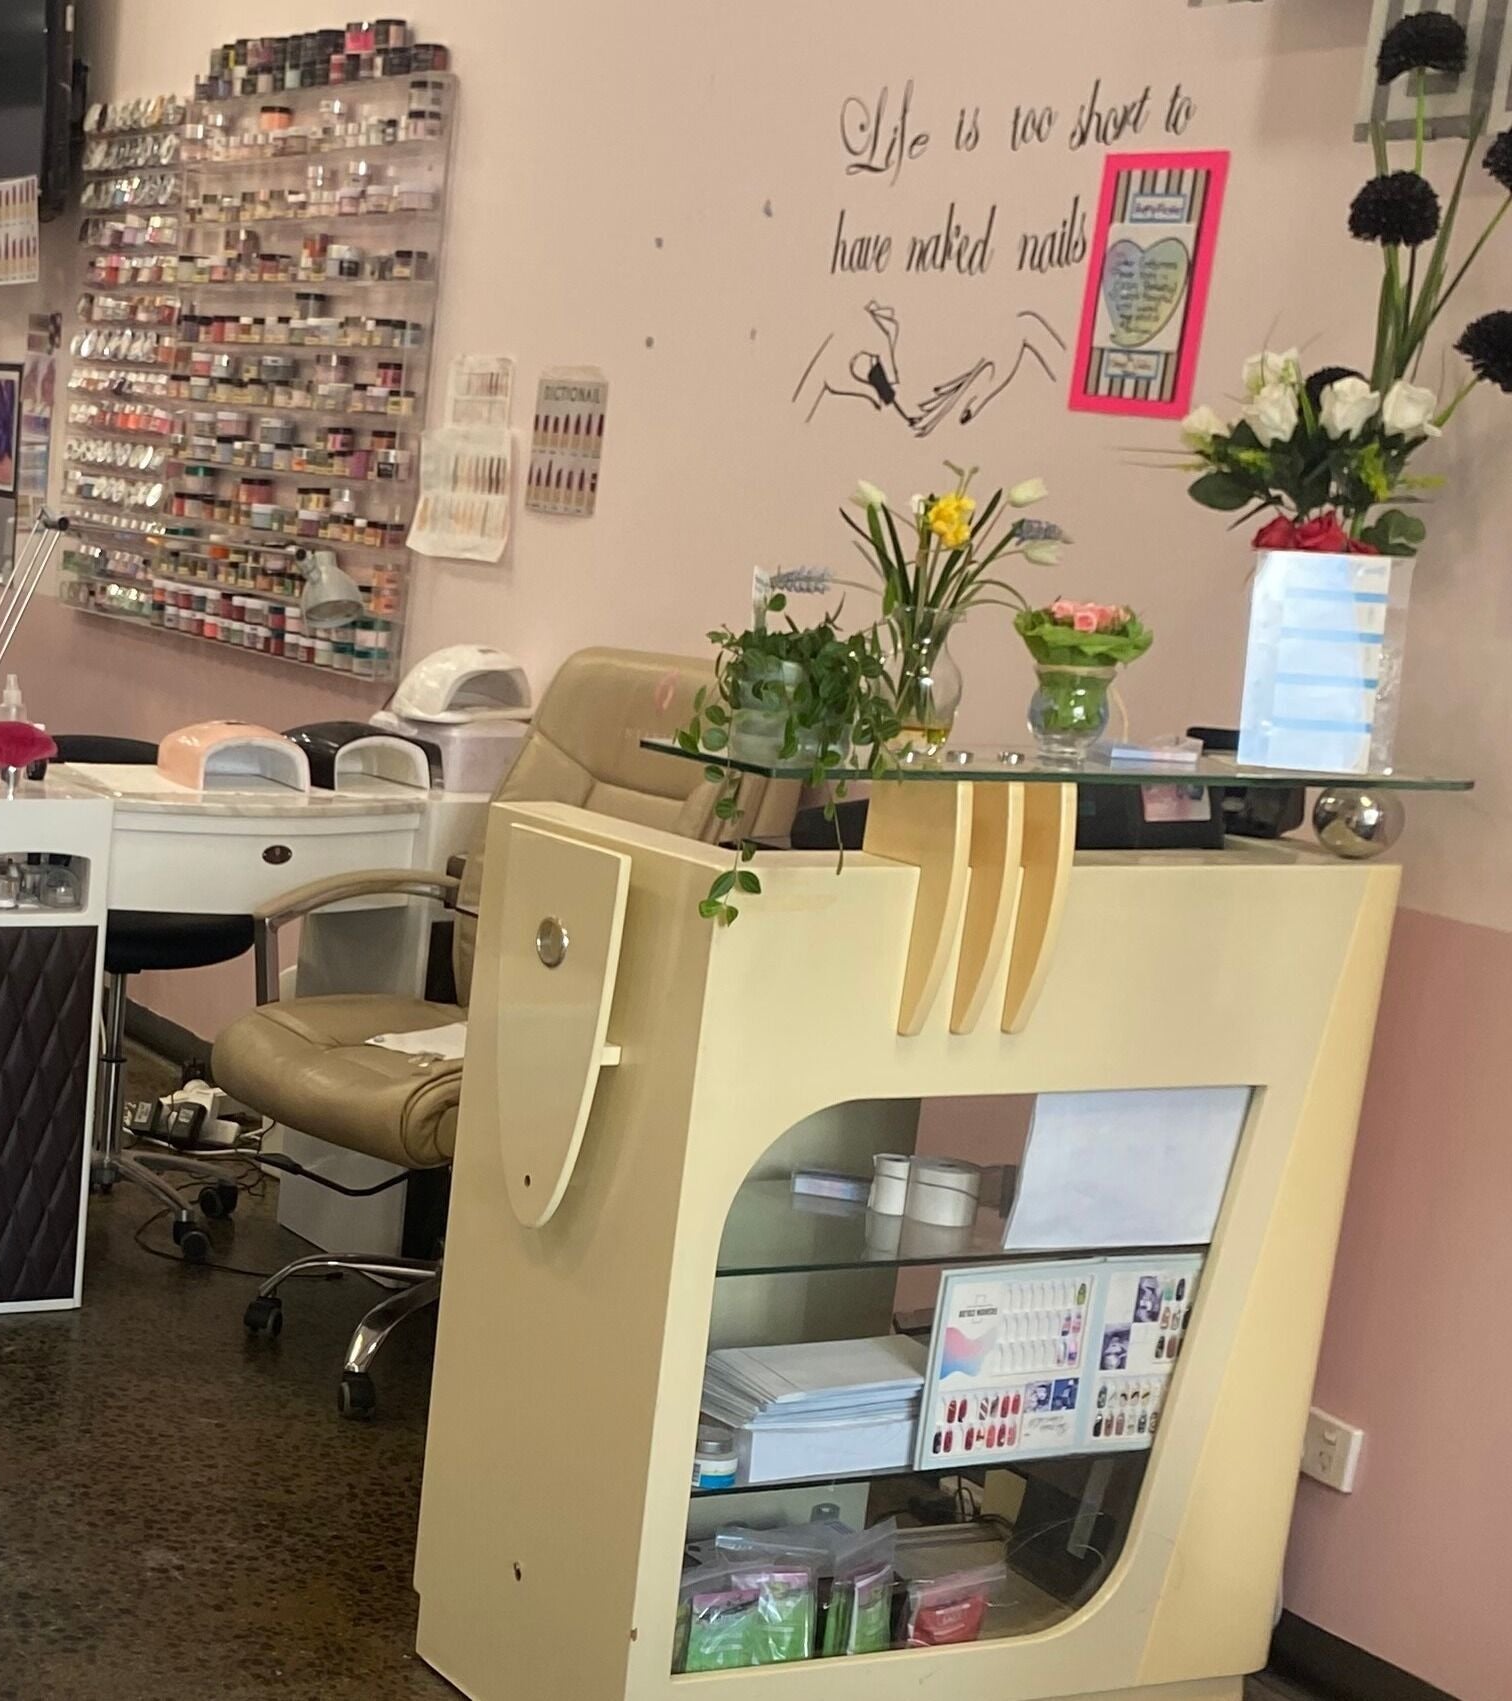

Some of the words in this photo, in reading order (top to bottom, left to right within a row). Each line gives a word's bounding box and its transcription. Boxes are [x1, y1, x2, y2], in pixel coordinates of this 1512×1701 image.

[840, 79, 929, 187] Life
[954, 106, 980, 152] is
[1011, 104, 1057, 152] too
[1069, 78, 1151, 151] short
[1164, 83, 1197, 136] to
[830, 208, 892, 274] have
[906, 202, 996, 276] naked
[1016, 195, 1087, 273] nails
